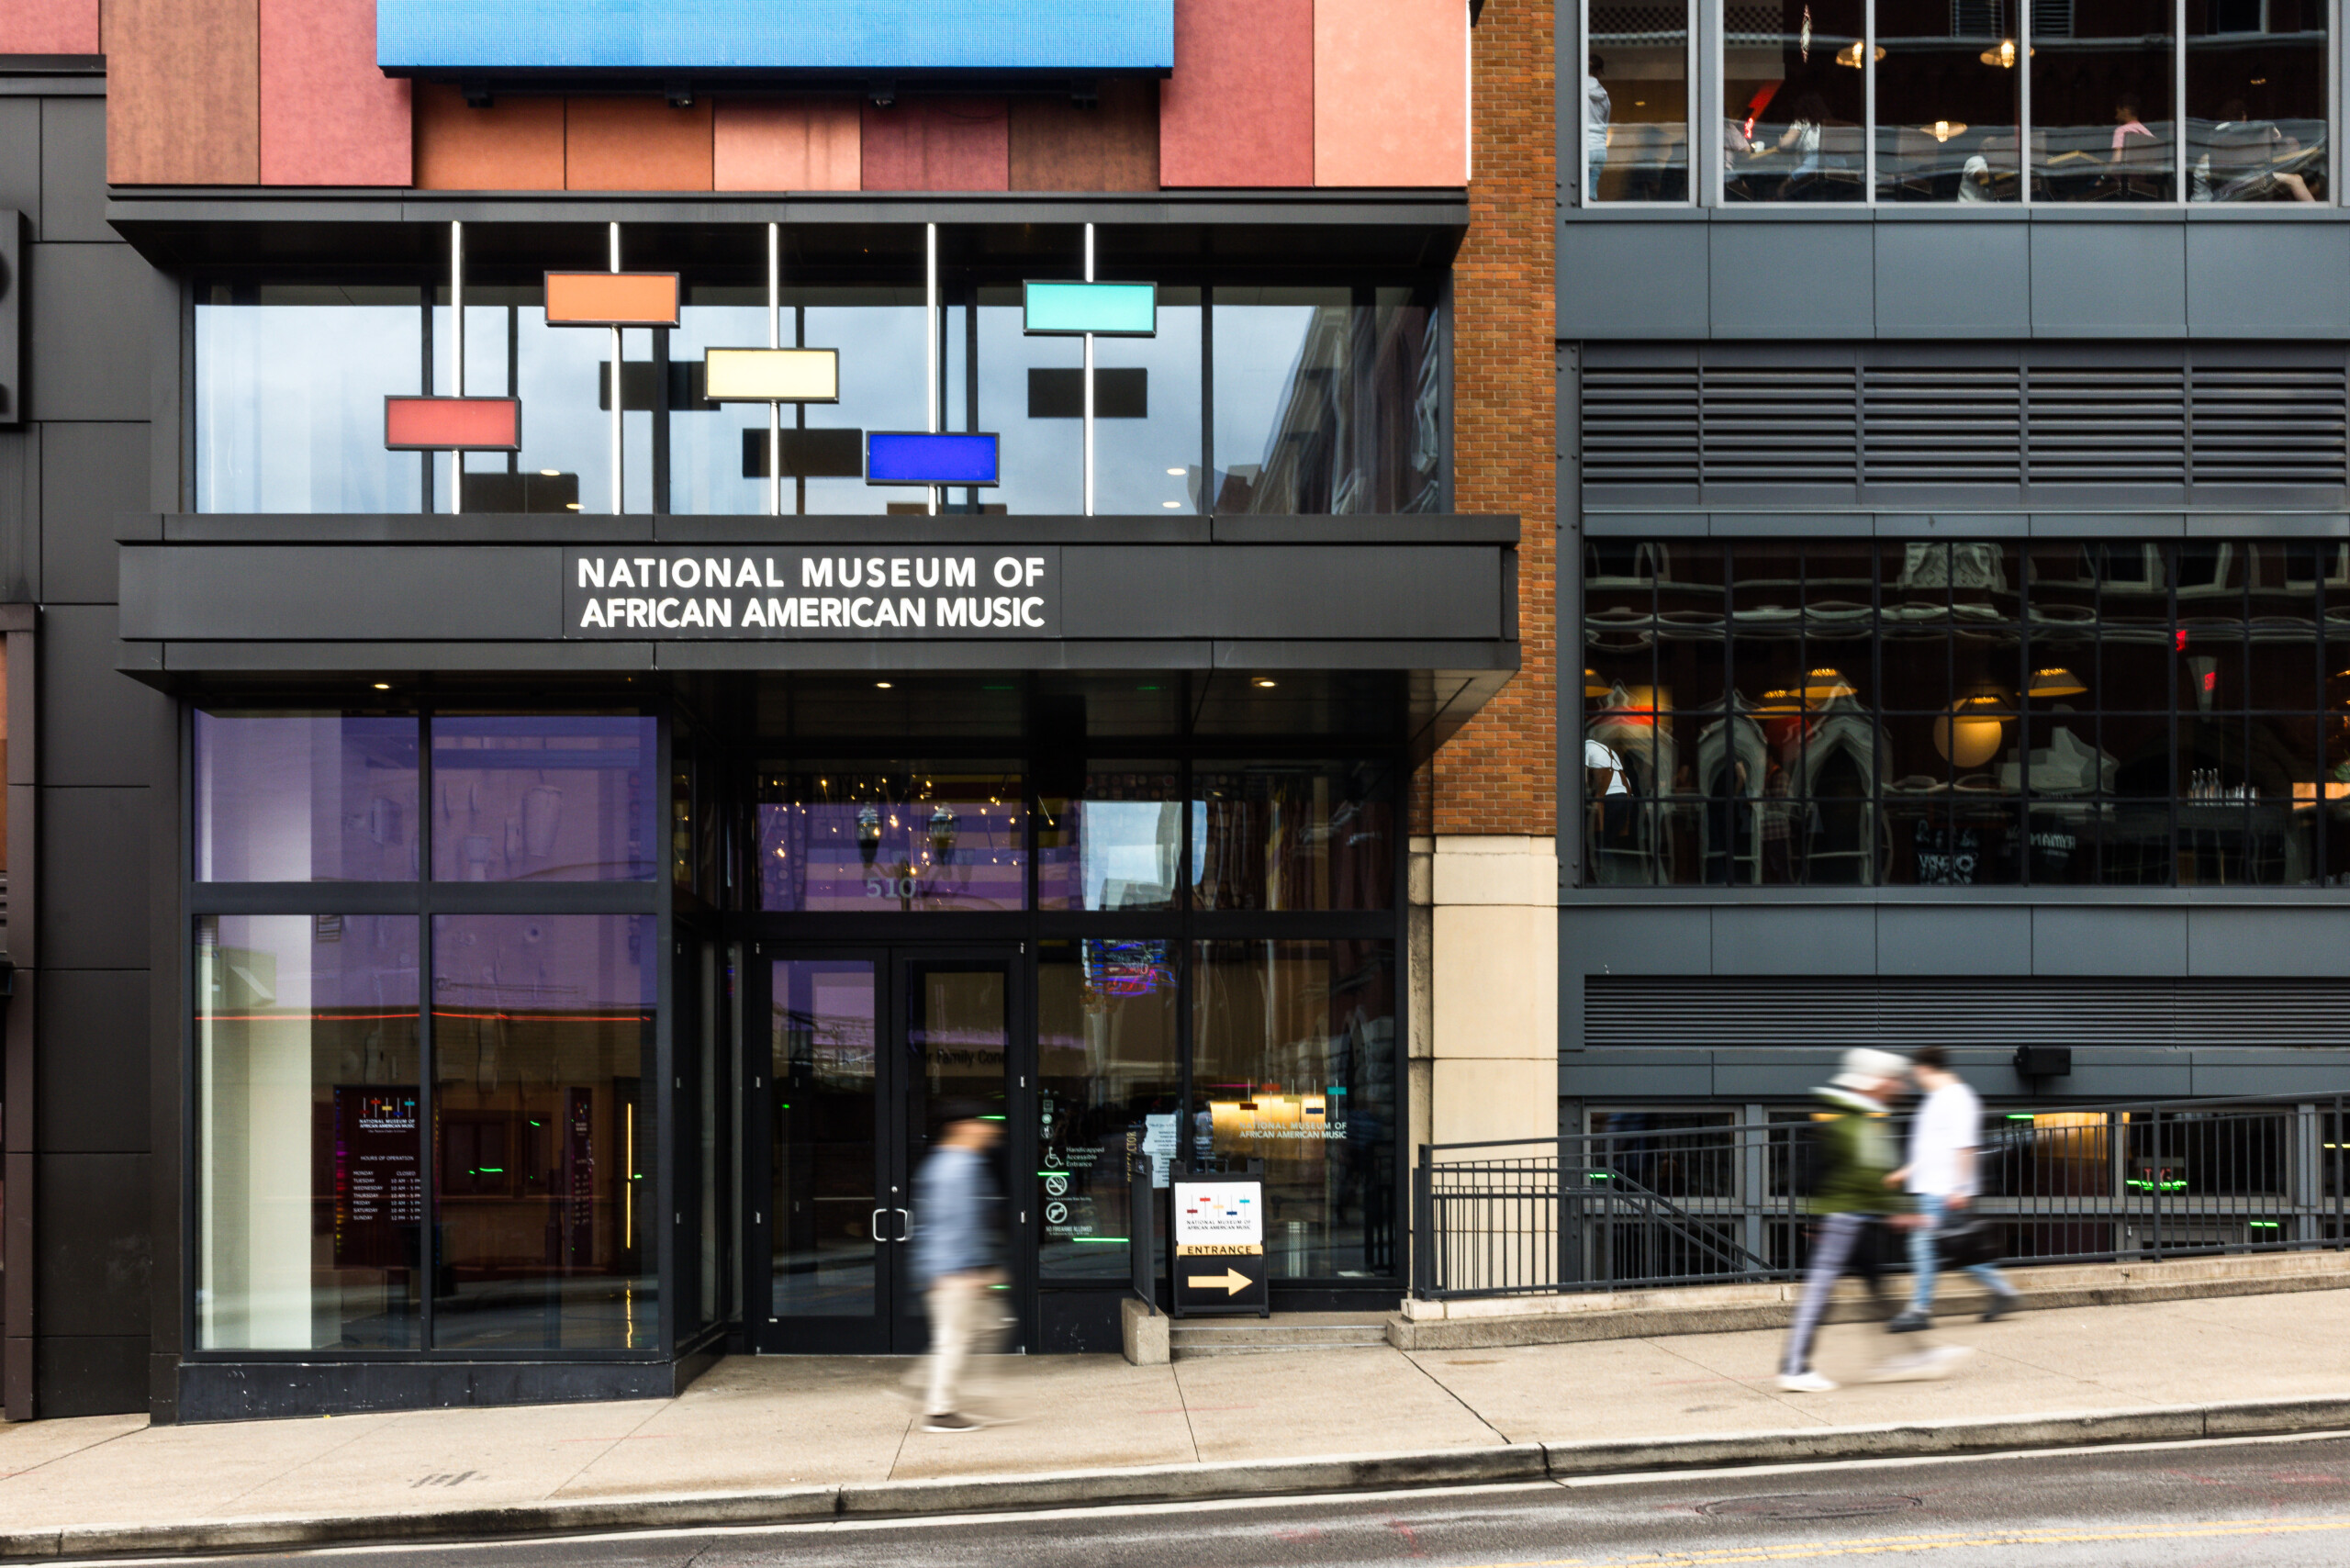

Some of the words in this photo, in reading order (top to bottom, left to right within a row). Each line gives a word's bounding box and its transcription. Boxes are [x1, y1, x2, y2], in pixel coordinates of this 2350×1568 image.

[577, 557, 784, 588] NATIONAL
[801, 557, 977, 588] MUSEUM
[993, 557, 1046, 588] OF
[580, 597, 732, 629] AFRICAN
[741, 597, 926, 629] AMERICAN
[936, 597, 1046, 629] MUSIC
[867, 877, 916, 898] 510
[936, 1049, 973, 1068] Family
[1239, 1121, 1286, 1130] NATIONAL
[1290, 1121, 1331, 1130] MUSEUM
[1334, 1121, 1348, 1130] OF
[1239, 1130, 1275, 1139] AFRICAN
[1276, 1130, 1320, 1139] AMERICAN
[1321, 1130, 1348, 1139] MUSIC
[1187, 1246, 1252, 1255] ENTRANCE
